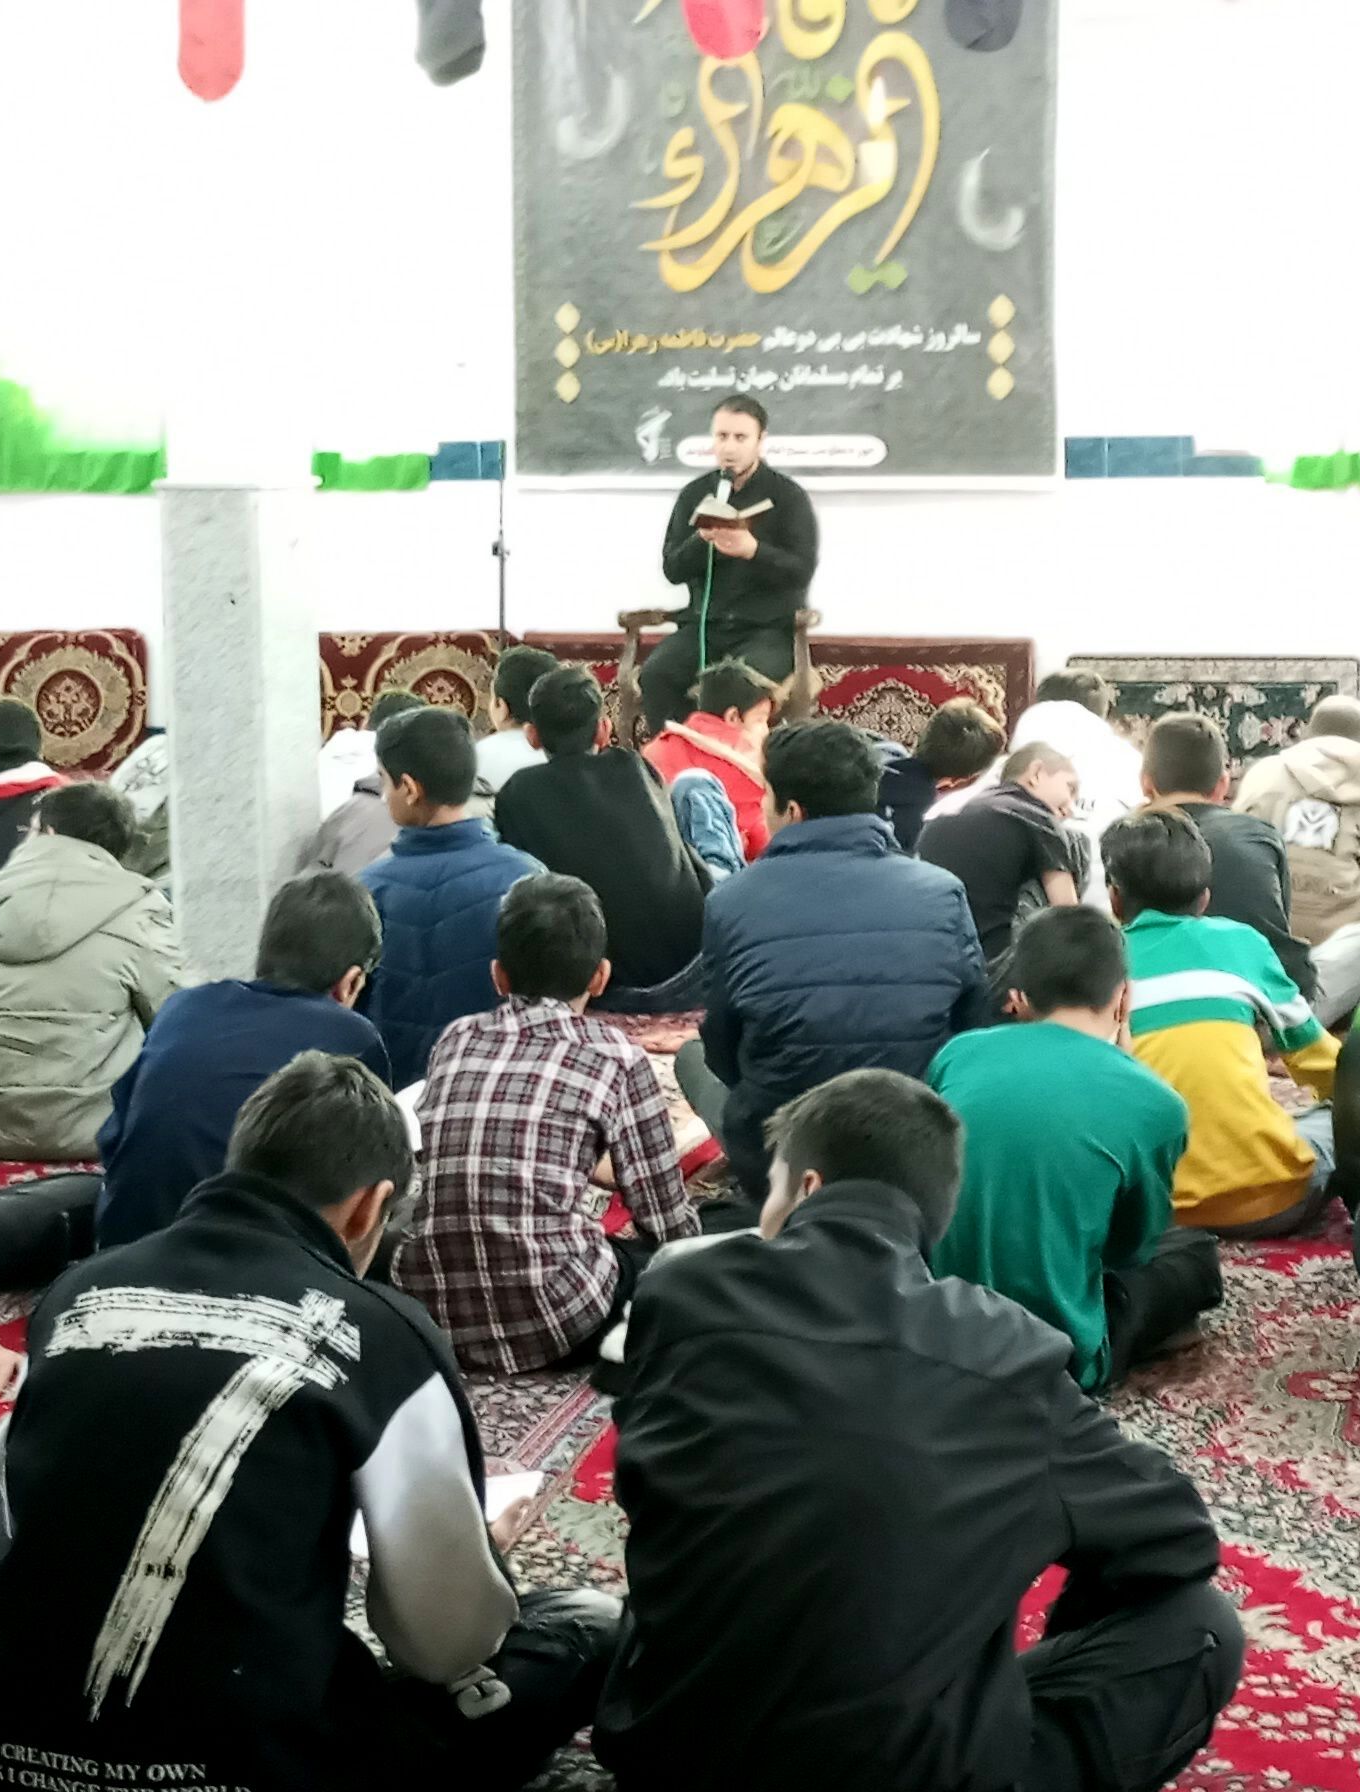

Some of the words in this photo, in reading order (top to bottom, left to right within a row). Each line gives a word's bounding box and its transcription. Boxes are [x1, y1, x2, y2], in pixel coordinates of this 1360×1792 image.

[0, 1742, 100, 1778] CREATING
[104, 1761, 141, 1782] MY
[146, 1763, 207, 1783] OWN
